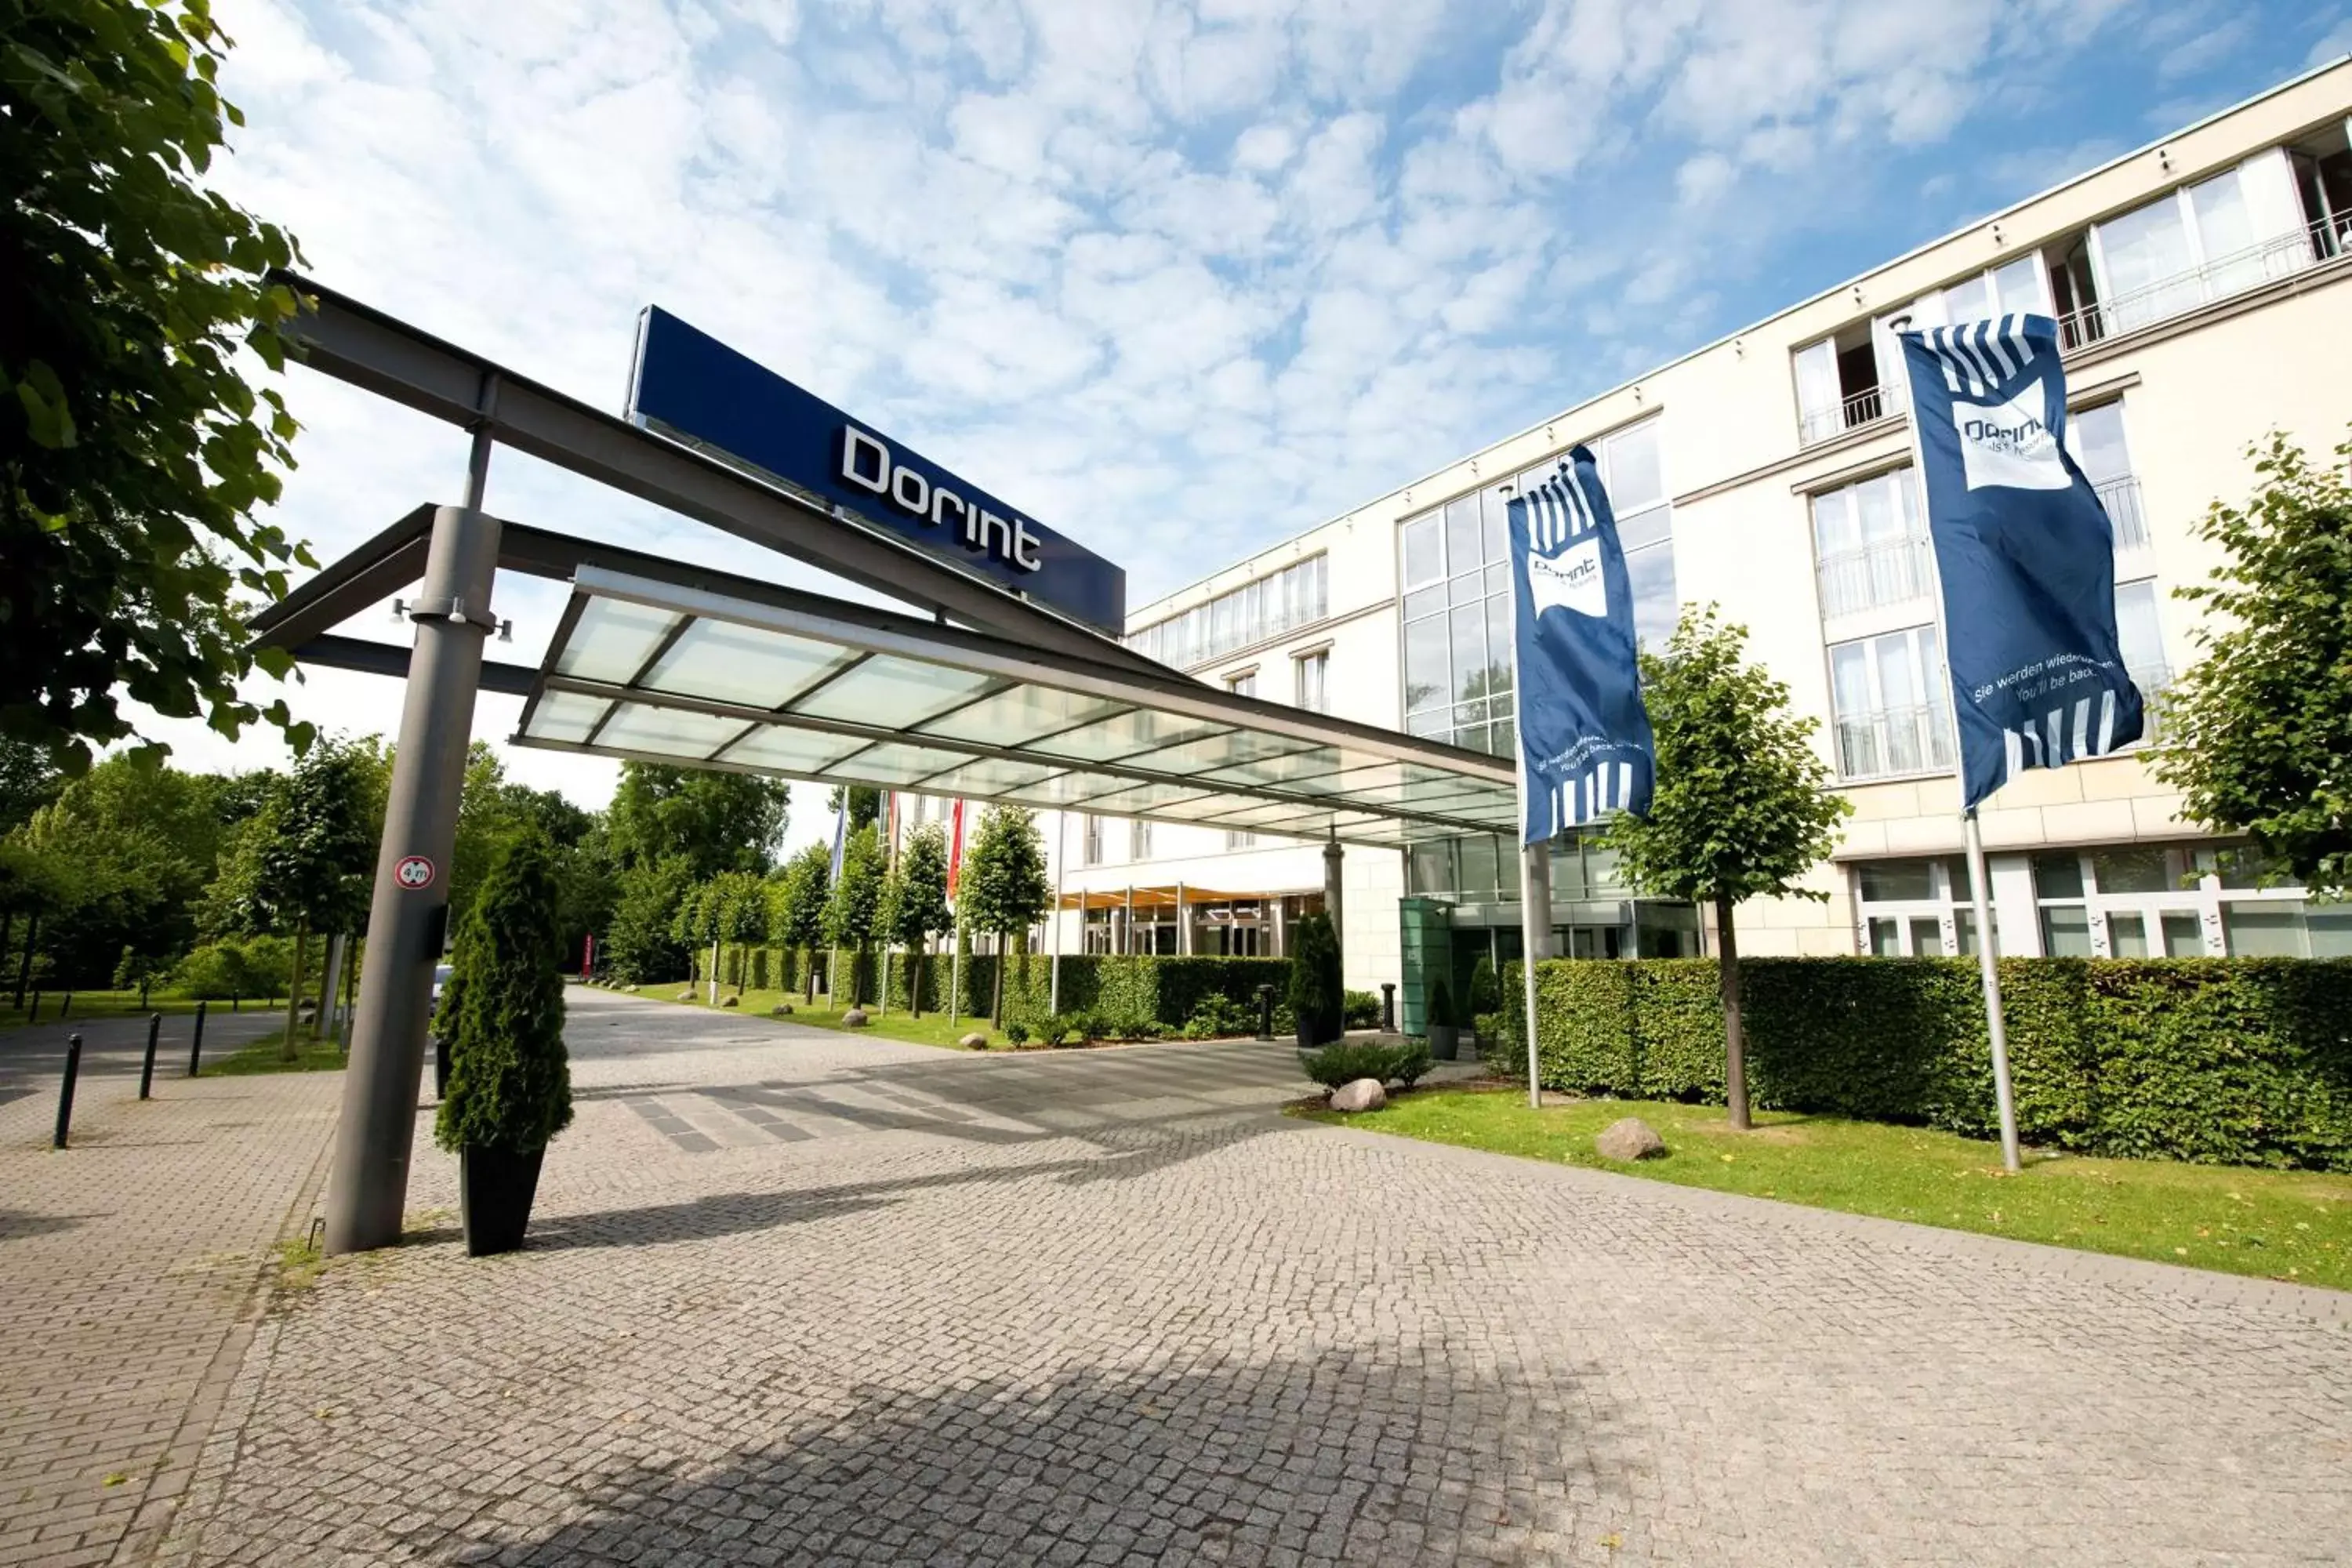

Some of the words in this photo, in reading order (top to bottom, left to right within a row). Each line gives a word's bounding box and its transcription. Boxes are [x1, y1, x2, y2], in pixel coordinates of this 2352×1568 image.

[841, 424, 1041, 572] Dorint
[1974, 684, 1994, 704] Sie
[1997, 662, 2042, 689] werden
[2050, 675, 2066, 690] be
